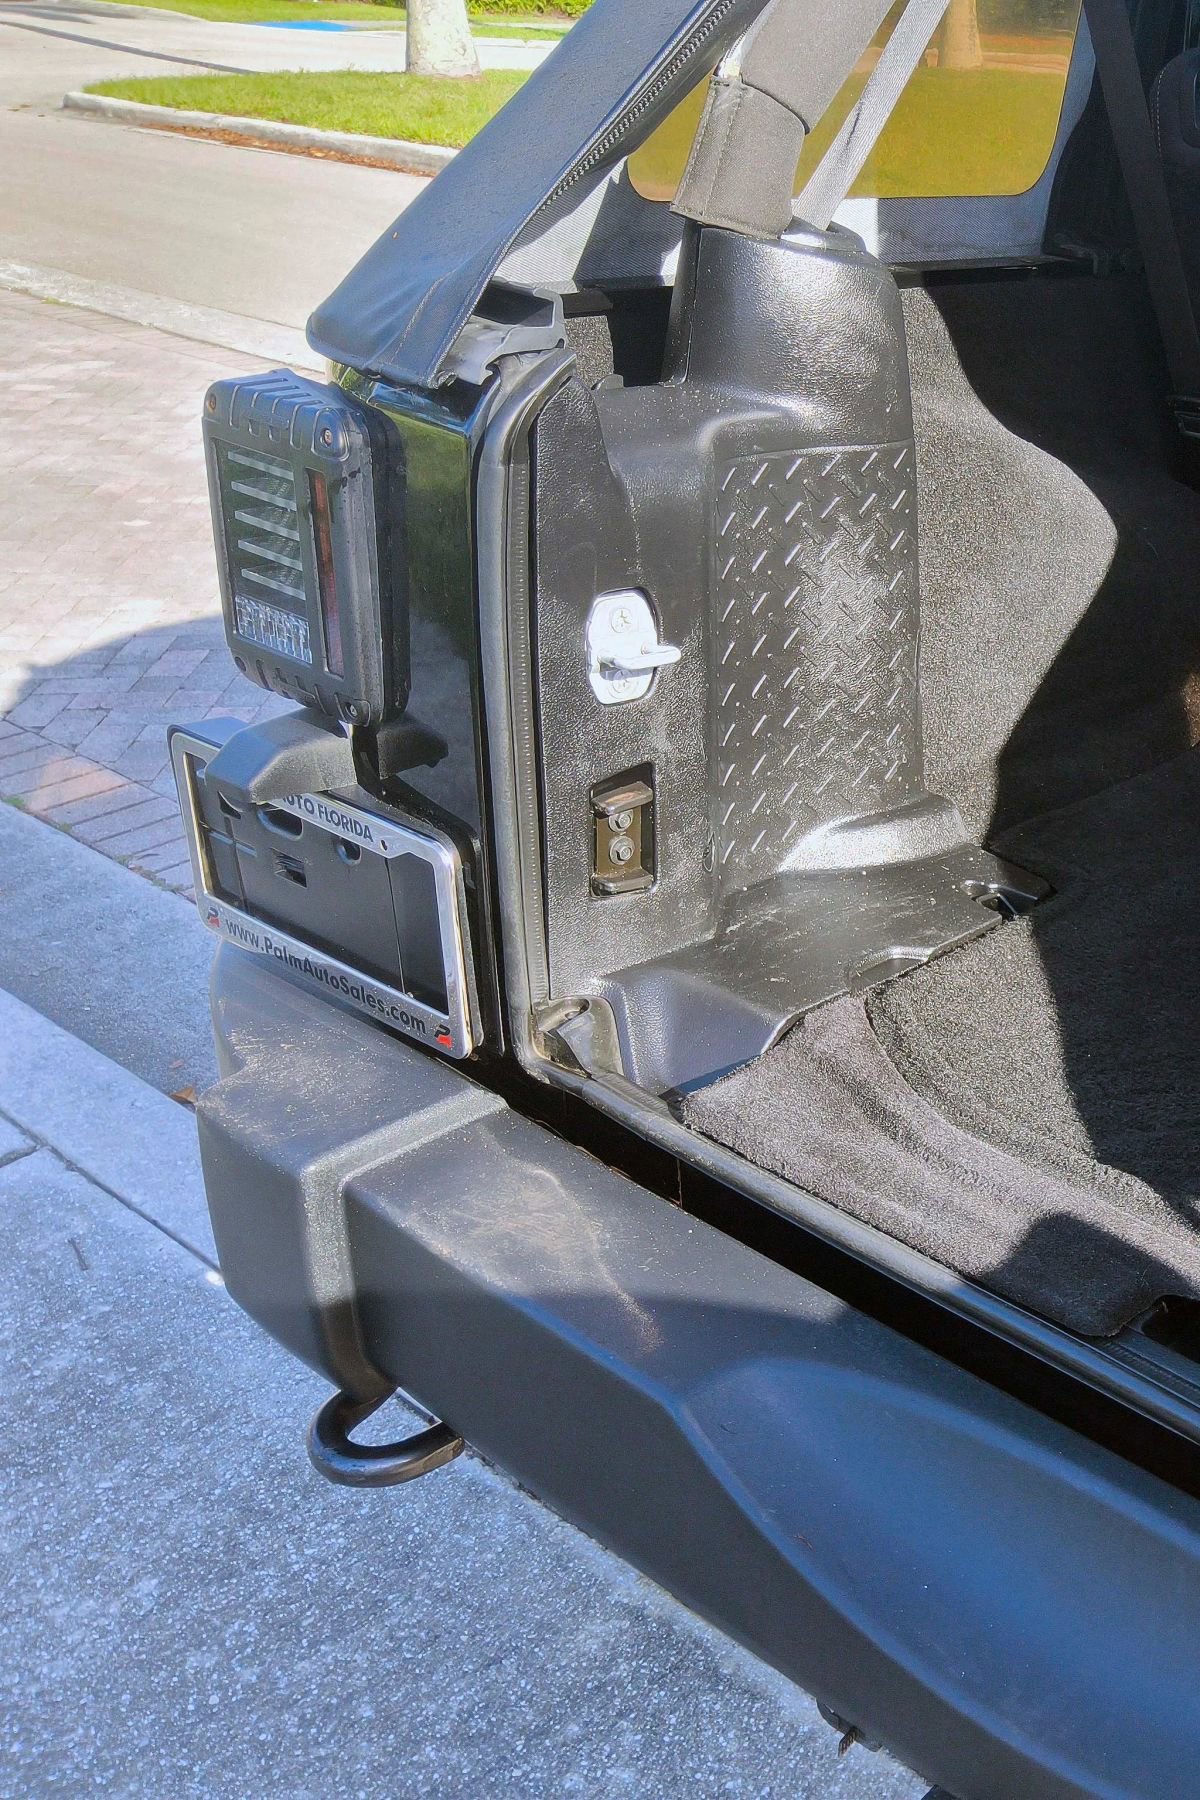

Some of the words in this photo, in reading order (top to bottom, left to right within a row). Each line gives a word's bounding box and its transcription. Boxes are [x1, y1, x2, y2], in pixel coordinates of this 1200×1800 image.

[282, 793, 315, 815] UTO
[317, 803, 374, 843] FLORIDA
[225, 918, 427, 1035] www.PalmAutoSales.com
